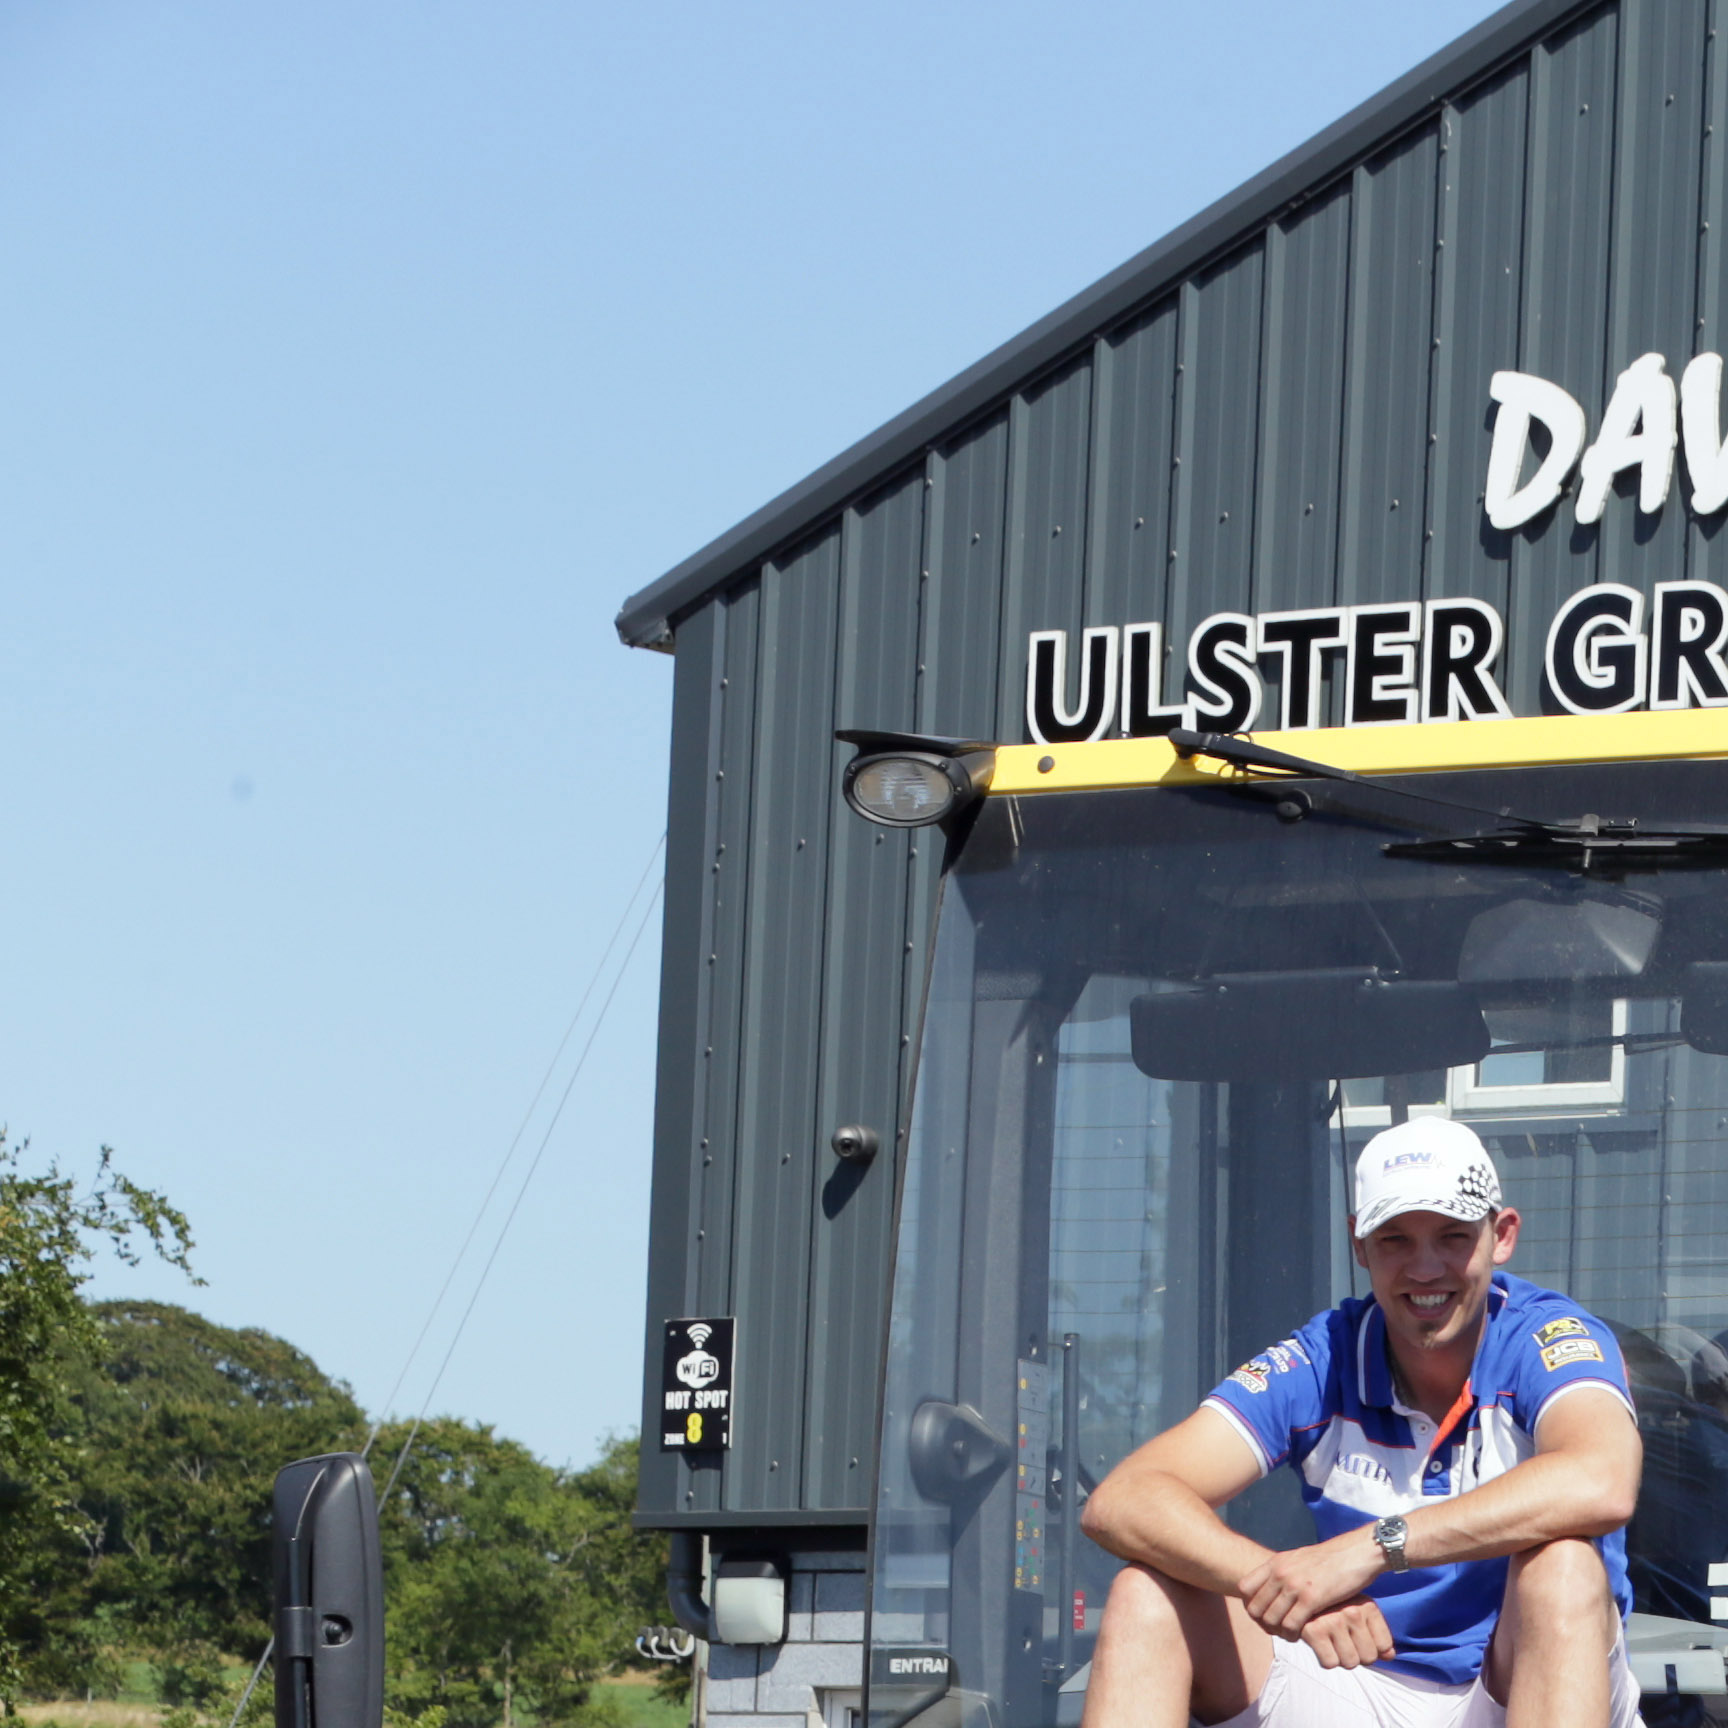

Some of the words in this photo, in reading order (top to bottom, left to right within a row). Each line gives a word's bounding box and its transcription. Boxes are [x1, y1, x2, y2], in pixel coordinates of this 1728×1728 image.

[1026, 597, 1512, 746] ULSTER
[665, 1391, 691, 1410] HOT
[694, 1390, 728, 1409] SPOT
